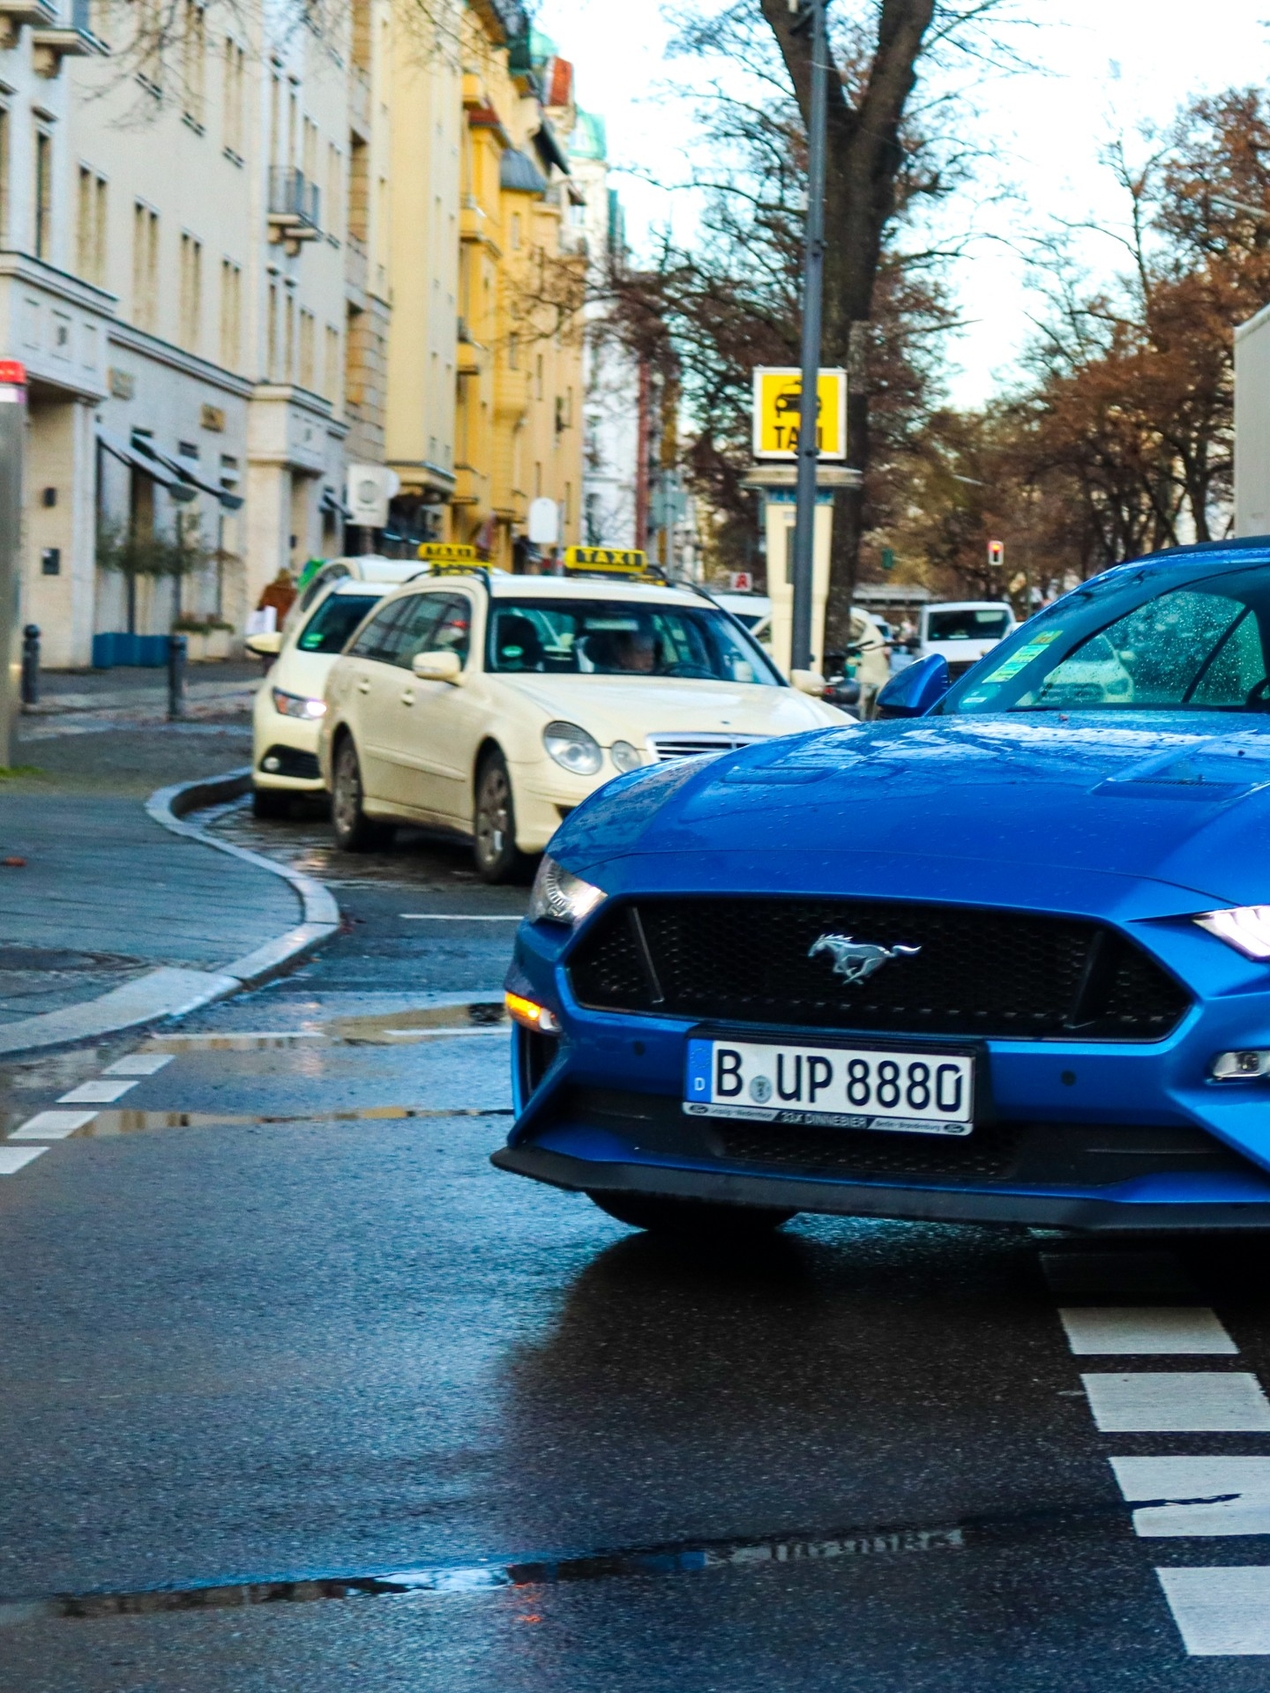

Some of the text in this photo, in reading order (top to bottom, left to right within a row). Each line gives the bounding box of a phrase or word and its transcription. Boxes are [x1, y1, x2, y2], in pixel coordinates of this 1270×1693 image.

[773, 426, 823, 449] TAI
[585, 549, 637, 565] TAXI
[694, 1077, 705, 1091] D
[716, 1048, 963, 1113] B UP 8880
